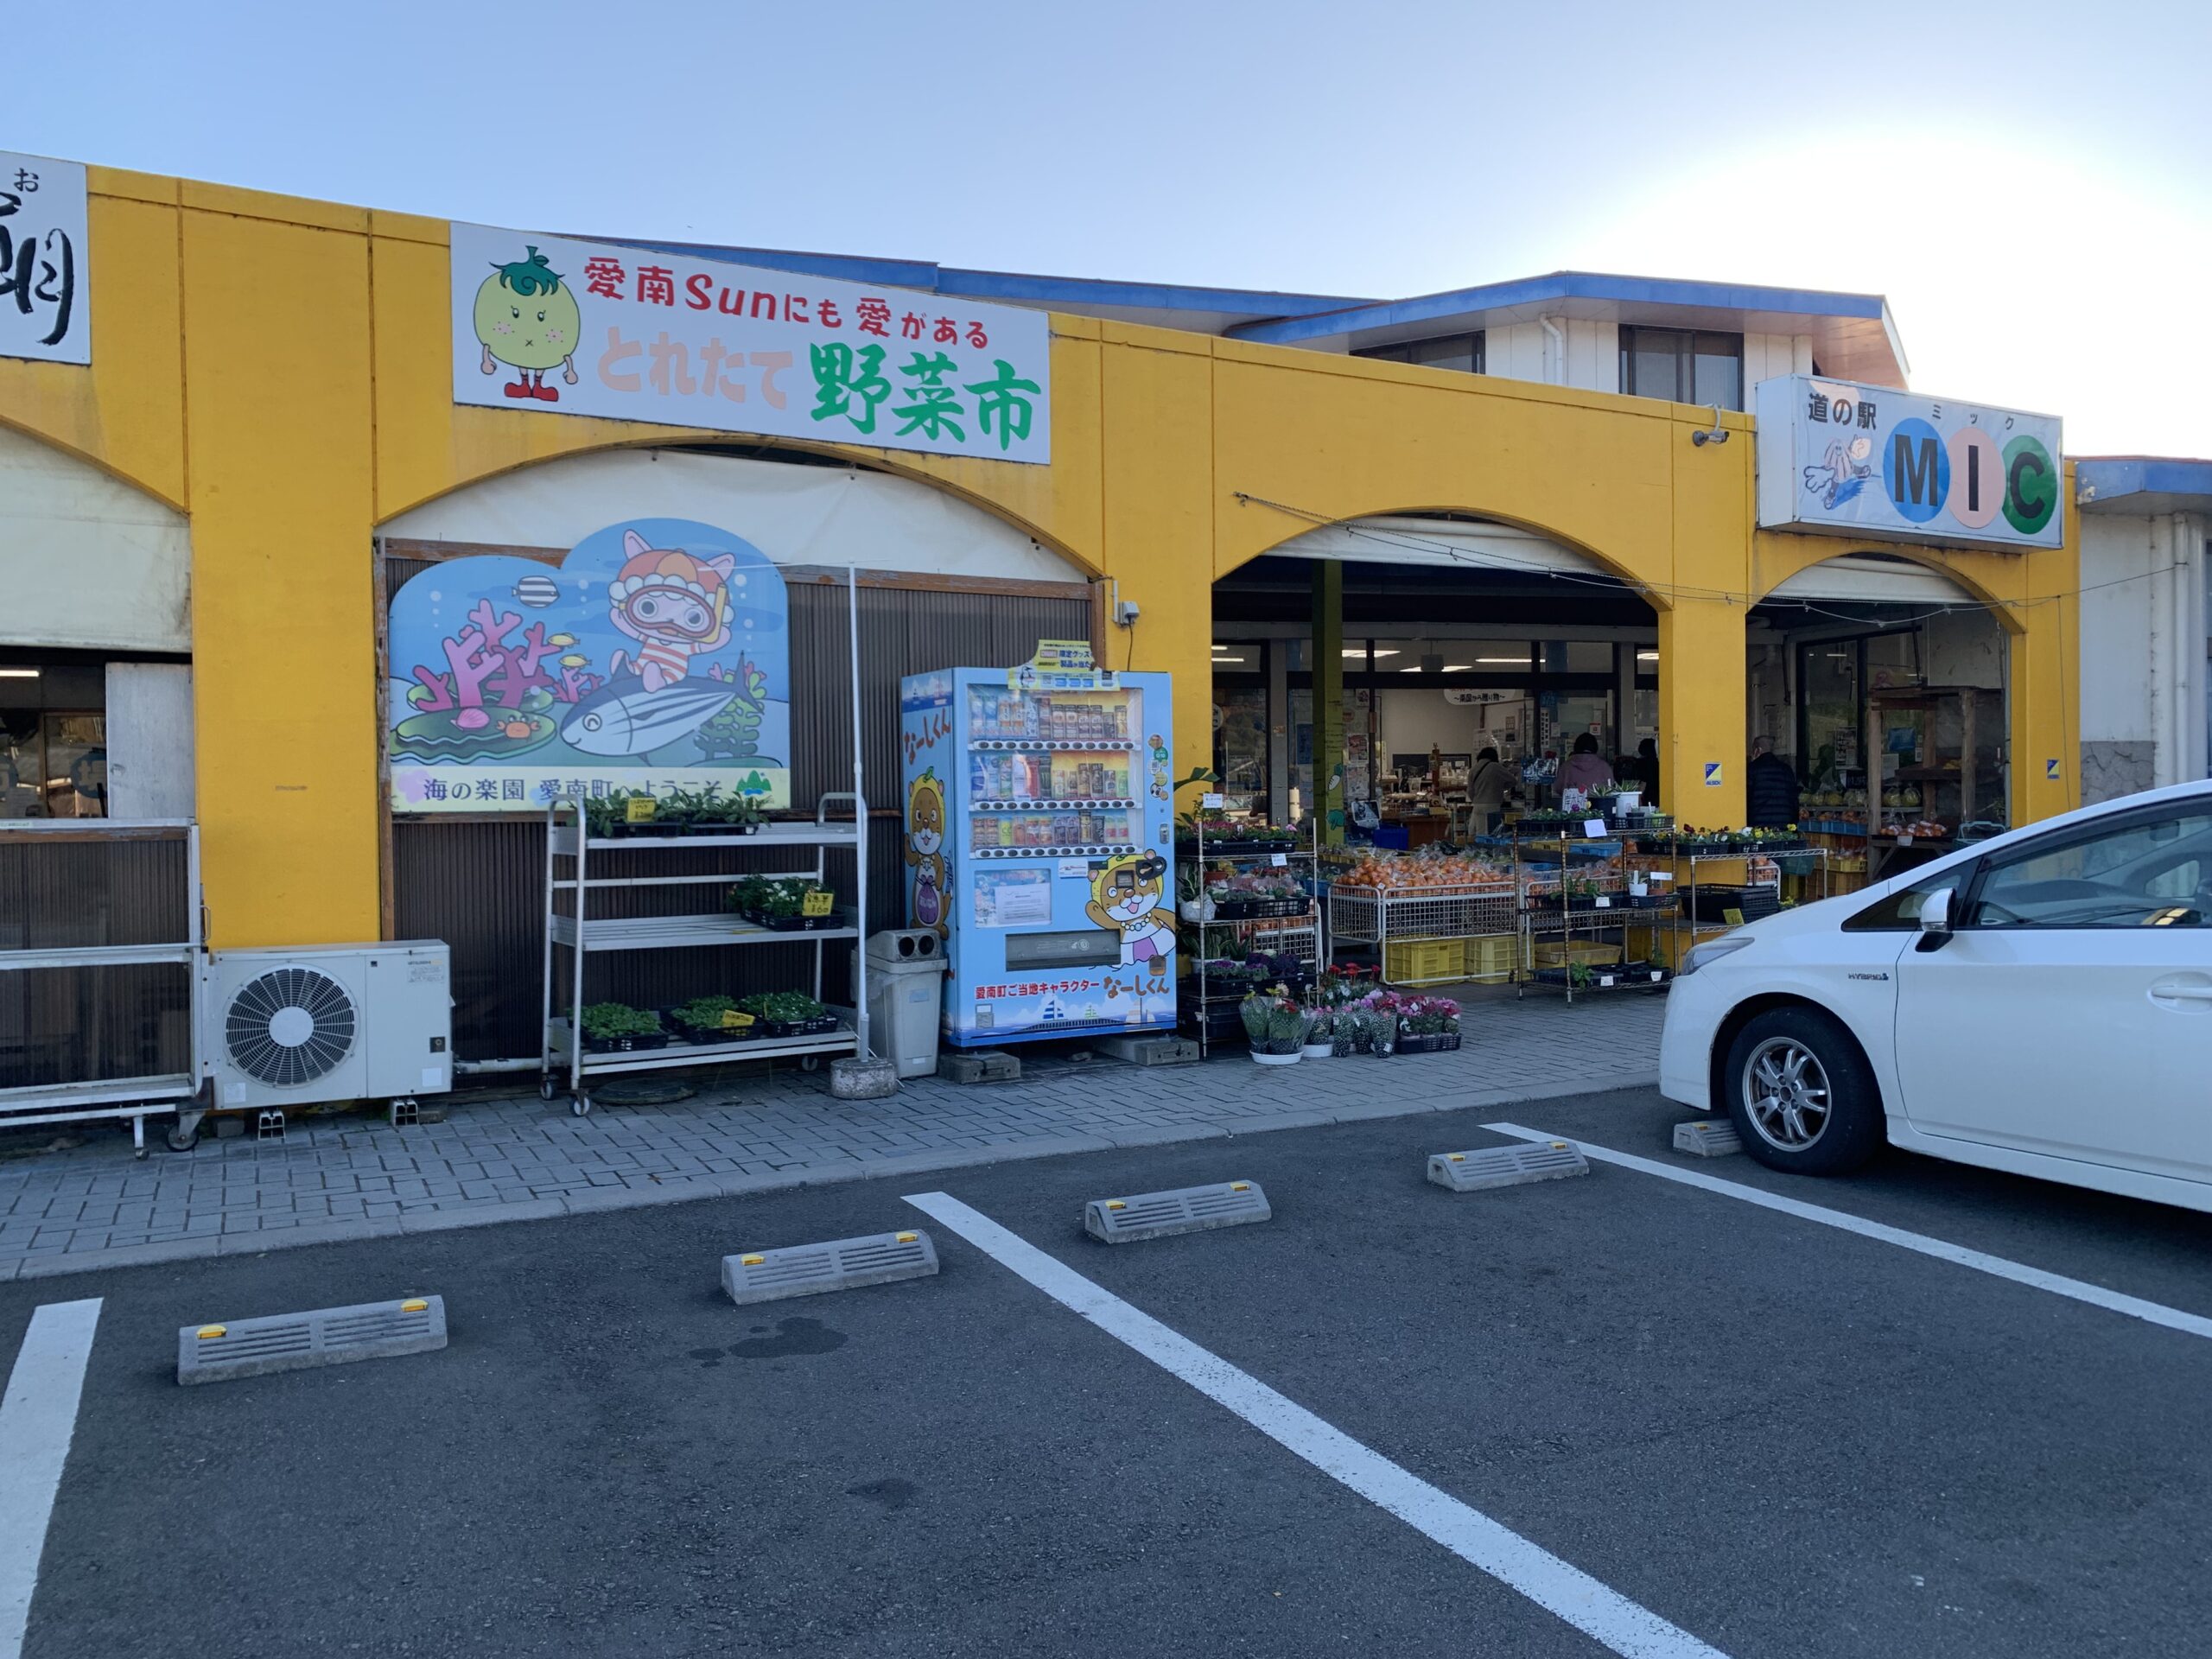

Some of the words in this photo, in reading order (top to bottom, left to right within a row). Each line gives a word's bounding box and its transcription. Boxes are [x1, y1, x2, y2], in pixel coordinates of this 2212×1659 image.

[584, 256, 988, 350] 愛南Sunにも愛がある
[1808, 391, 1877, 430] 道の駅
[1894, 434, 2045, 519] MIC
[423, 778, 525, 801] 海の楽園
[1103, 975, 1170, 999] なーしくん
